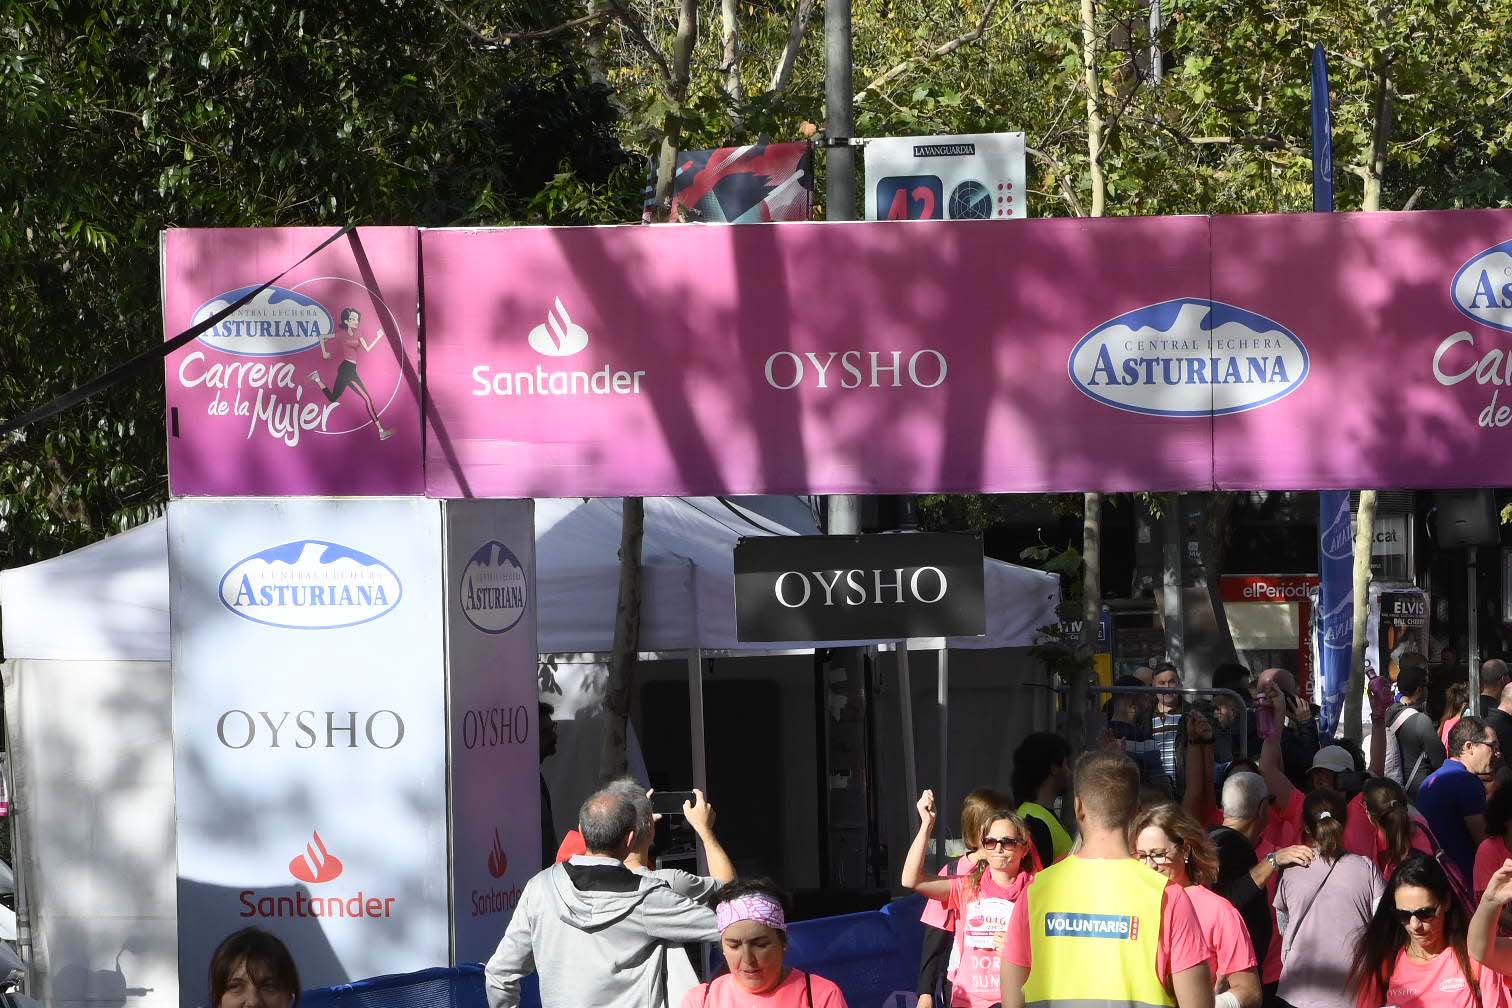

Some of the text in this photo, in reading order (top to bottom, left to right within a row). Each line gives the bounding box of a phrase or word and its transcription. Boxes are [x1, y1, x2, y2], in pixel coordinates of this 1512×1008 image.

[226, 309, 268, 318] ENTRAL
[1125, 338, 1281, 351] CENTRAL LECHERA
[179, 351, 296, 388] Carrera
[472, 364, 646, 396] Santander
[764, 349, 948, 390] OYSHO
[1087, 343, 1289, 386] ASTURIANA
[208, 384, 340, 447] de la Mujer
[1479, 389, 1512, 428] de
[234, 574, 389, 607] ASTURIANA
[466, 580, 523, 611] ASTURIANA
[774, 566, 948, 608] OYSHO
[1394, 601, 1424, 614] ELVIS
[216, 709, 405, 749] OYSHO
[462, 705, 529, 750] OYSHO
[240, 890, 395, 918] Santander
[1047, 918, 1128, 934] VOLUNTARIS
